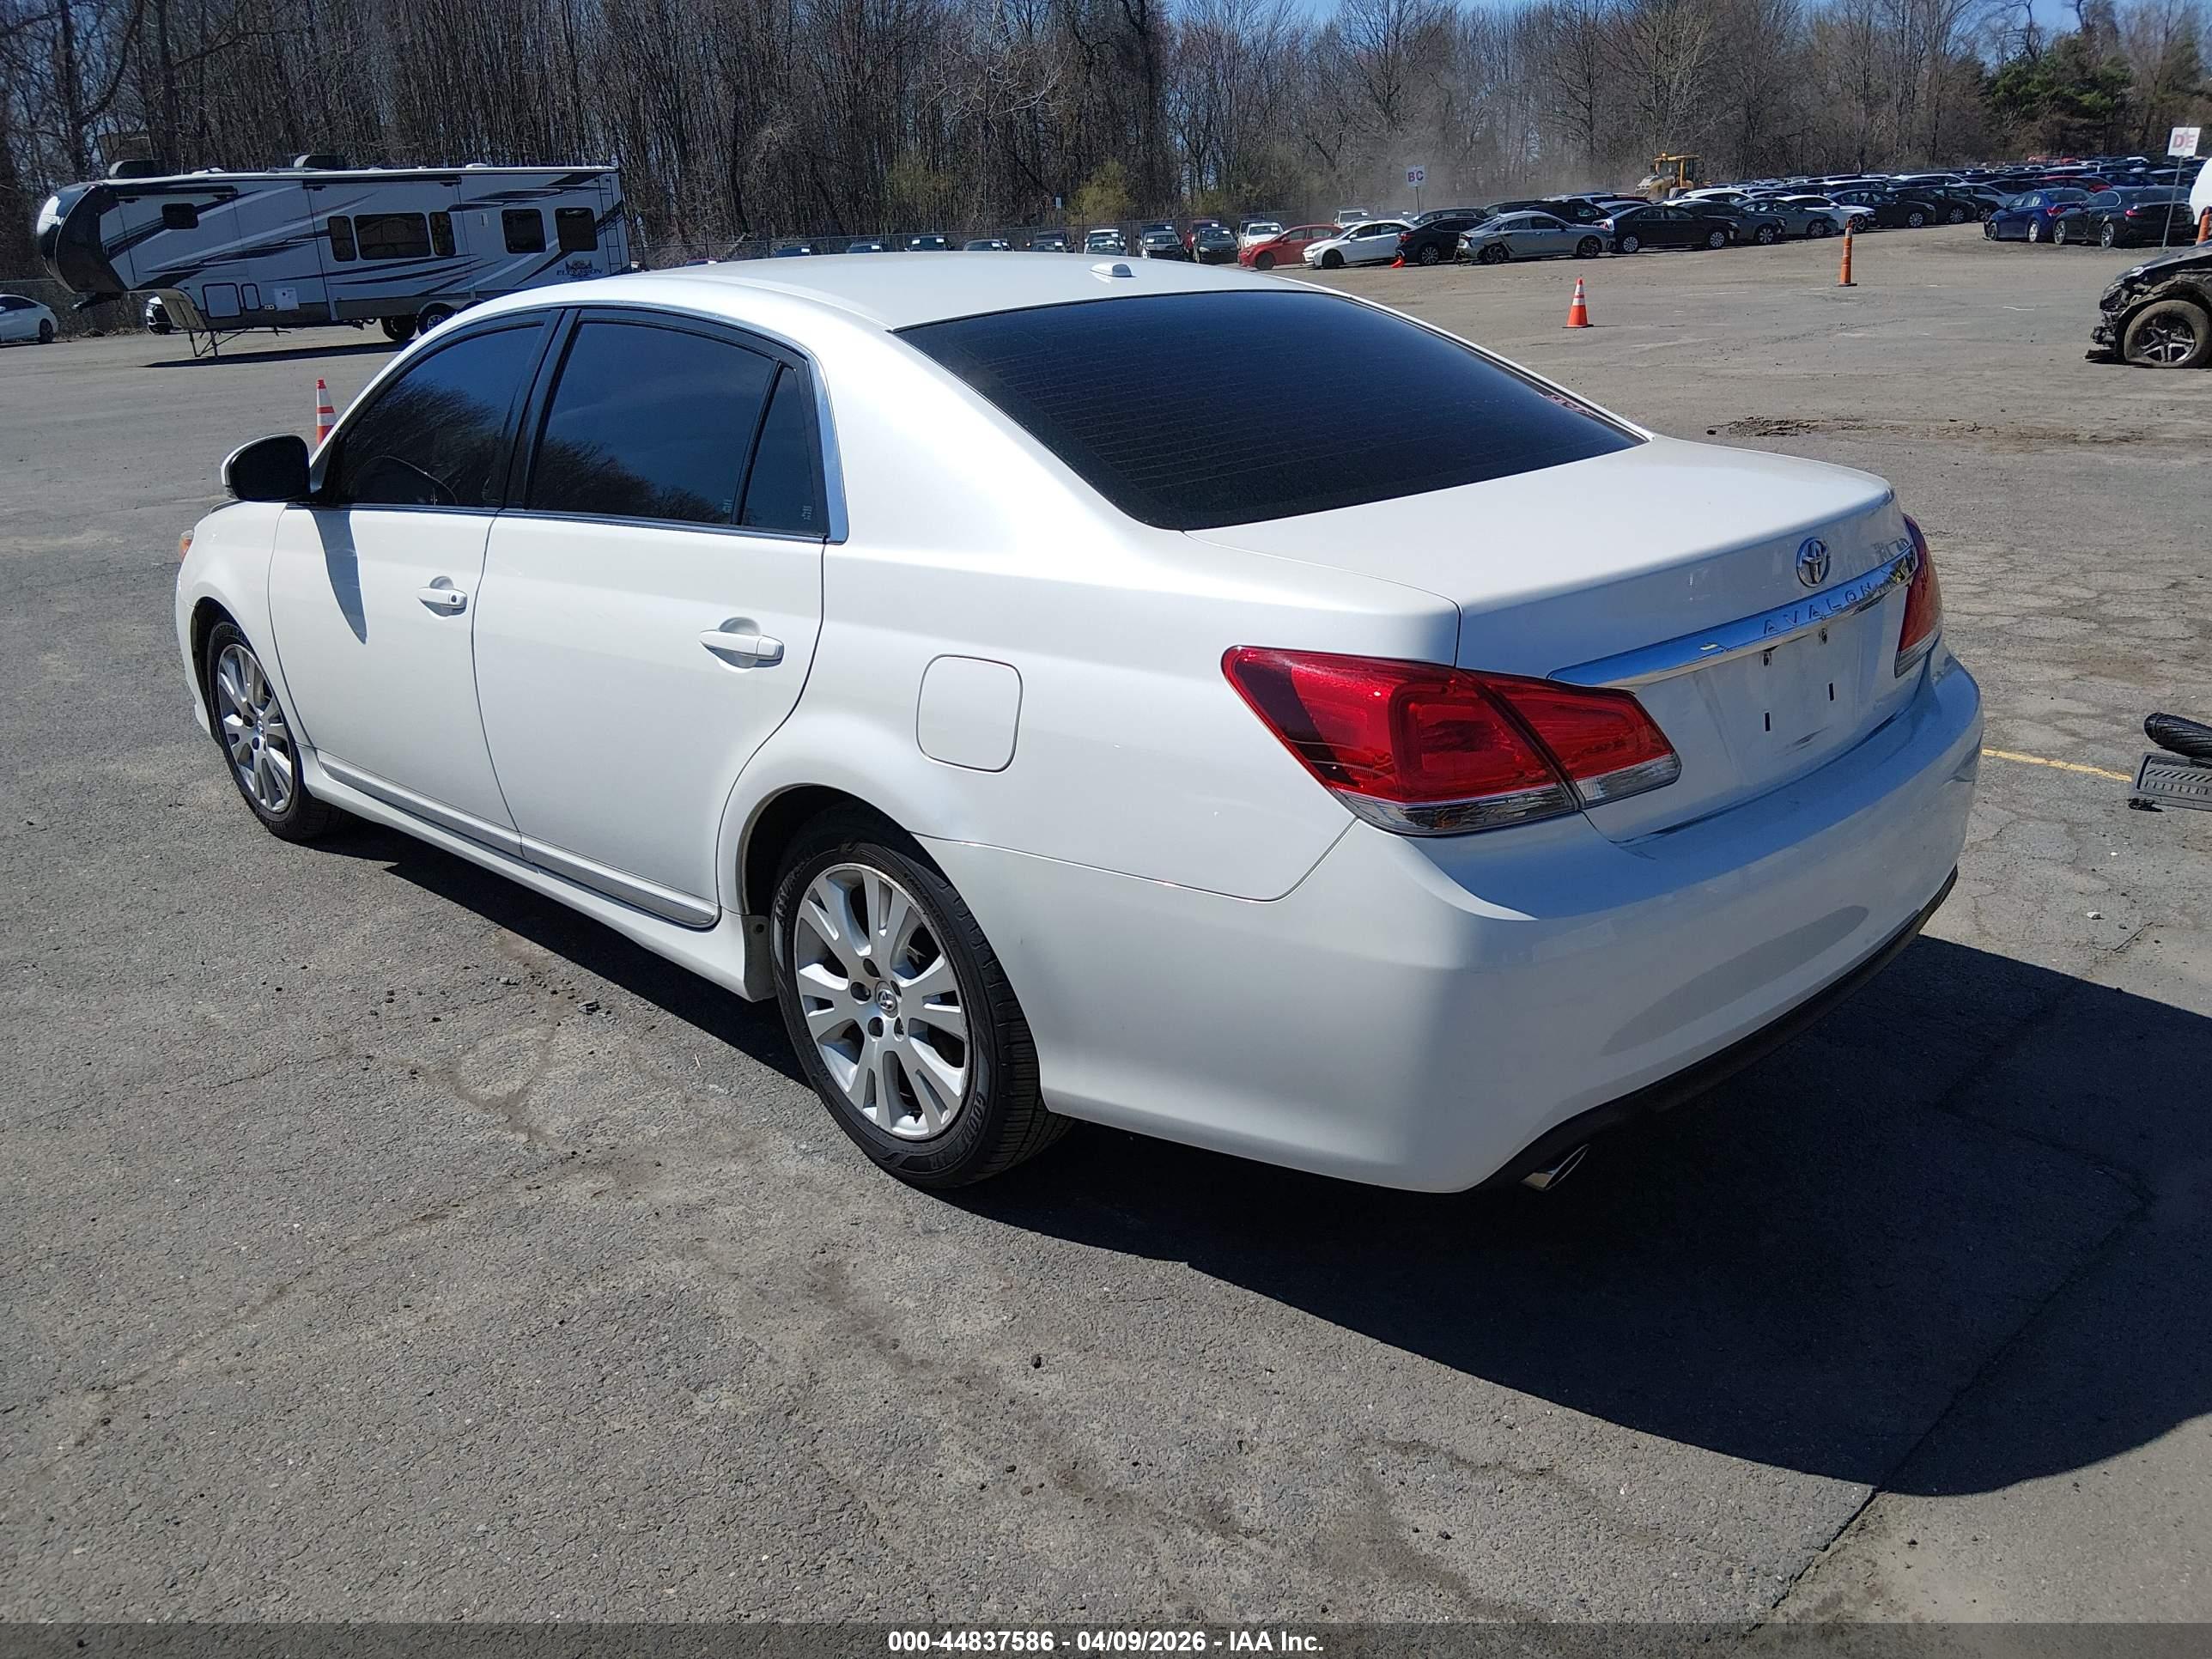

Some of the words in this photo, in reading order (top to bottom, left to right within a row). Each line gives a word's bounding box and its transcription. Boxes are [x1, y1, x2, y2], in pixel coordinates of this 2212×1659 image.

[2172, 133, 2196, 149] DE
[1407, 170, 1424, 183] BC
[1762, 581, 1874, 635] AVALON
